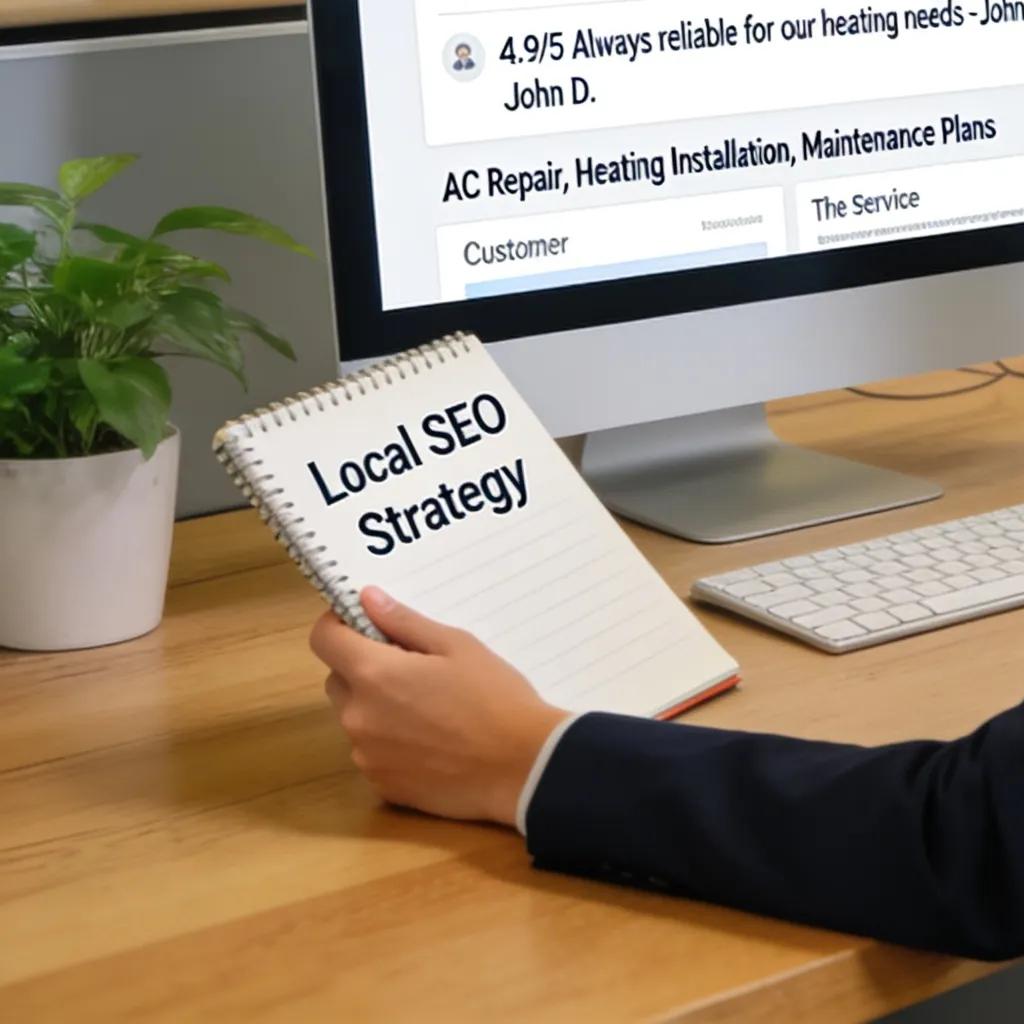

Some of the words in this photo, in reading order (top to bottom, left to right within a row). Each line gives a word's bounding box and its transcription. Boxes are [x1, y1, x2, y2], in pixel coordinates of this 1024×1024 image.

[499, 31, 564, 65] 4.9/5
[572, 28, 651, 62] Always
[658, 18, 738, 51] reliable
[743, 14, 775, 44] for
[781, 15, 815, 40] our
[821, 6, 899, 39] heating
[504, 78, 564, 112] John
[571, 76, 596, 105] D.
[442, 170, 481, 203] AC
[488, 161, 569, 201] Repair,
[575, 151, 664, 187] Heating
[671, 138, 797, 176] Installation,
[801, 125, 935, 161] Maintenance
[940, 114, 997, 145] Plans
[811, 195, 847, 222] The
[852, 188, 920, 215] Service
[464, 236, 569, 266] Customer
[307, 424, 423, 507] Local
[421, 393, 507, 457] SEO
[357, 458, 529, 557] Strategy
